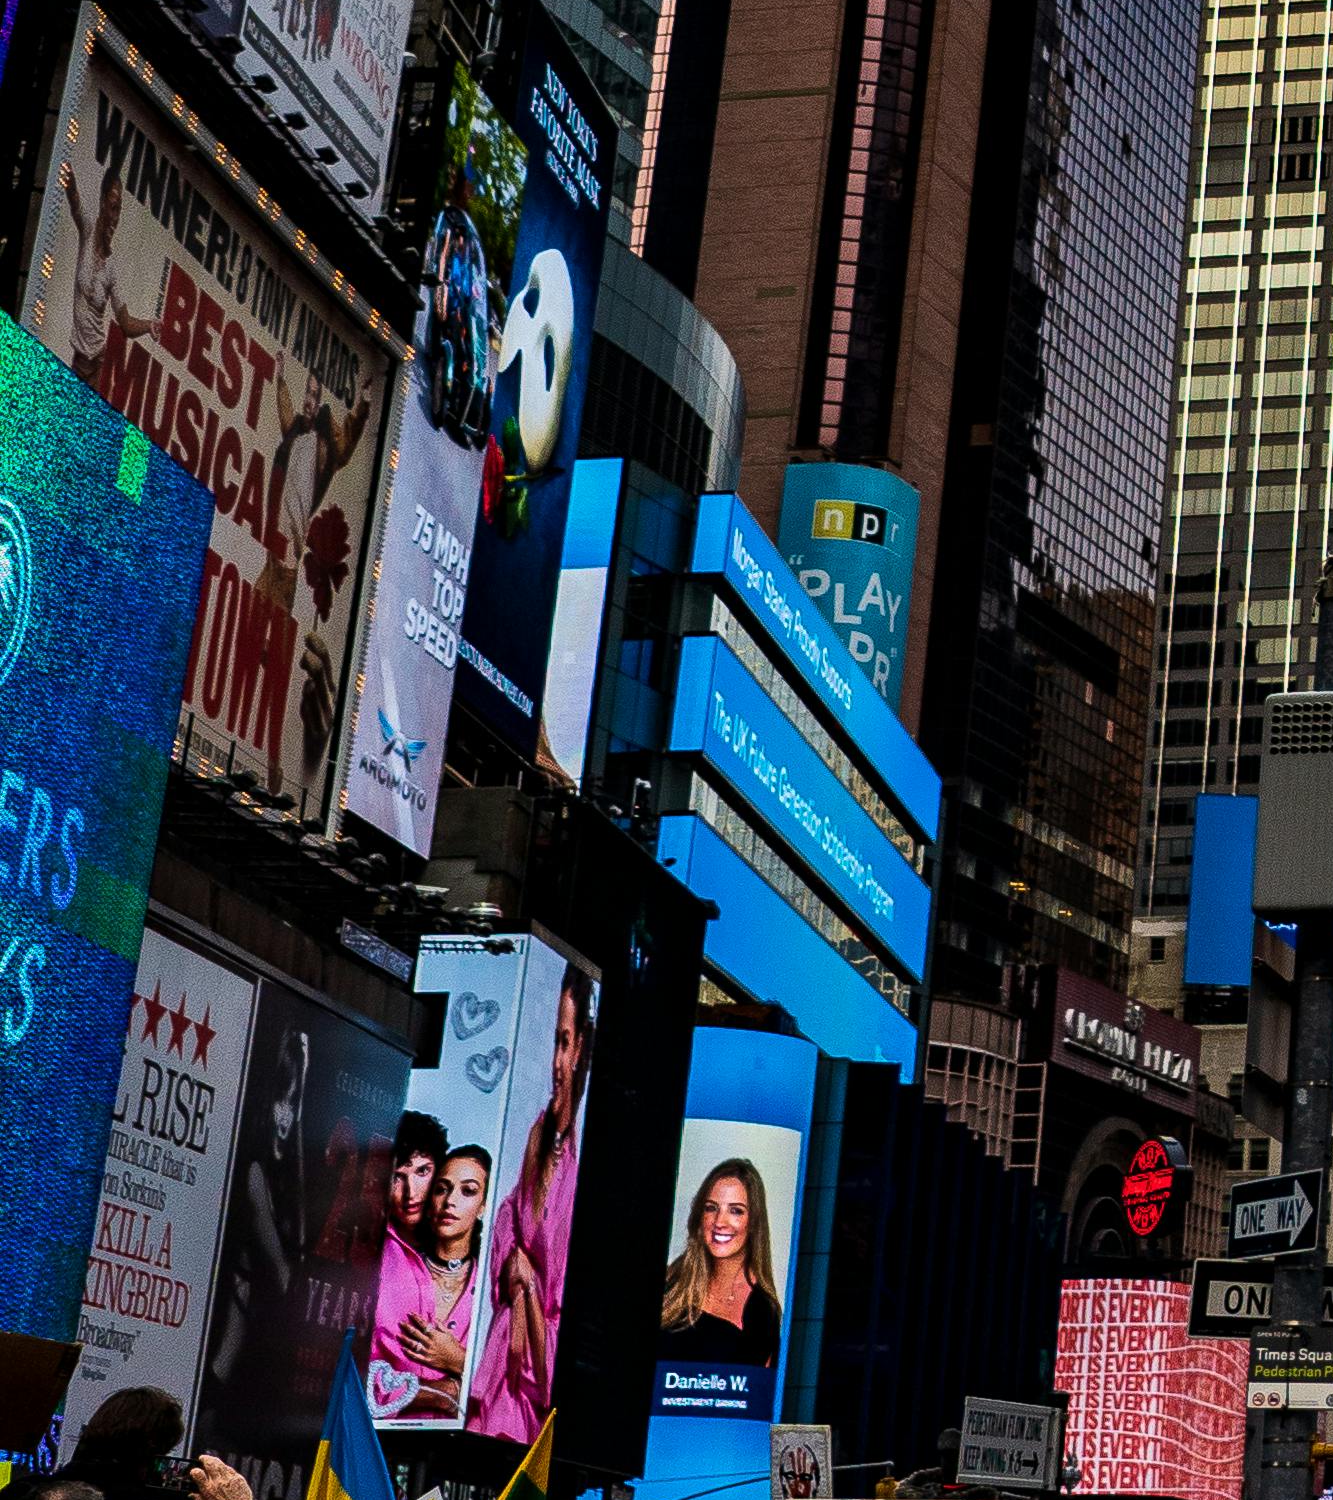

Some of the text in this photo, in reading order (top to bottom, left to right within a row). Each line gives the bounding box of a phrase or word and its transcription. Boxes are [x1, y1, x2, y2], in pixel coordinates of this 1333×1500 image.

[95, 89, 239, 292] WINNER!
[250, 253, 295, 342] TONY
[291, 288, 362, 411] AWARDS
[161, 261, 279, 411] BEST
[97, 342, 289, 562] MUSICAL
[412, 503, 472, 585] 75 MPH
[823, 507, 900, 544] npr
[432, 570, 466, 625] TOP
[731, 527, 764, 598] Morgan
[763, 570, 793, 634] Stanley
[403, 597, 459, 670] SPEED
[358, 753, 428, 813] ARCIMOTO
[748, 734, 777, 795] Future
[777, 765, 822, 846] Generation
[140, 1057, 216, 1157] RISE
[95, 1201, 173, 1272] KILL A
[1240, 1197, 1306, 1235] ONE WAY
[664, 1372, 749, 1392] Danielle W.
[1254, 1364, 1322, 1378] Pedestrian
[1256, 1347, 1296, 1361] Times
